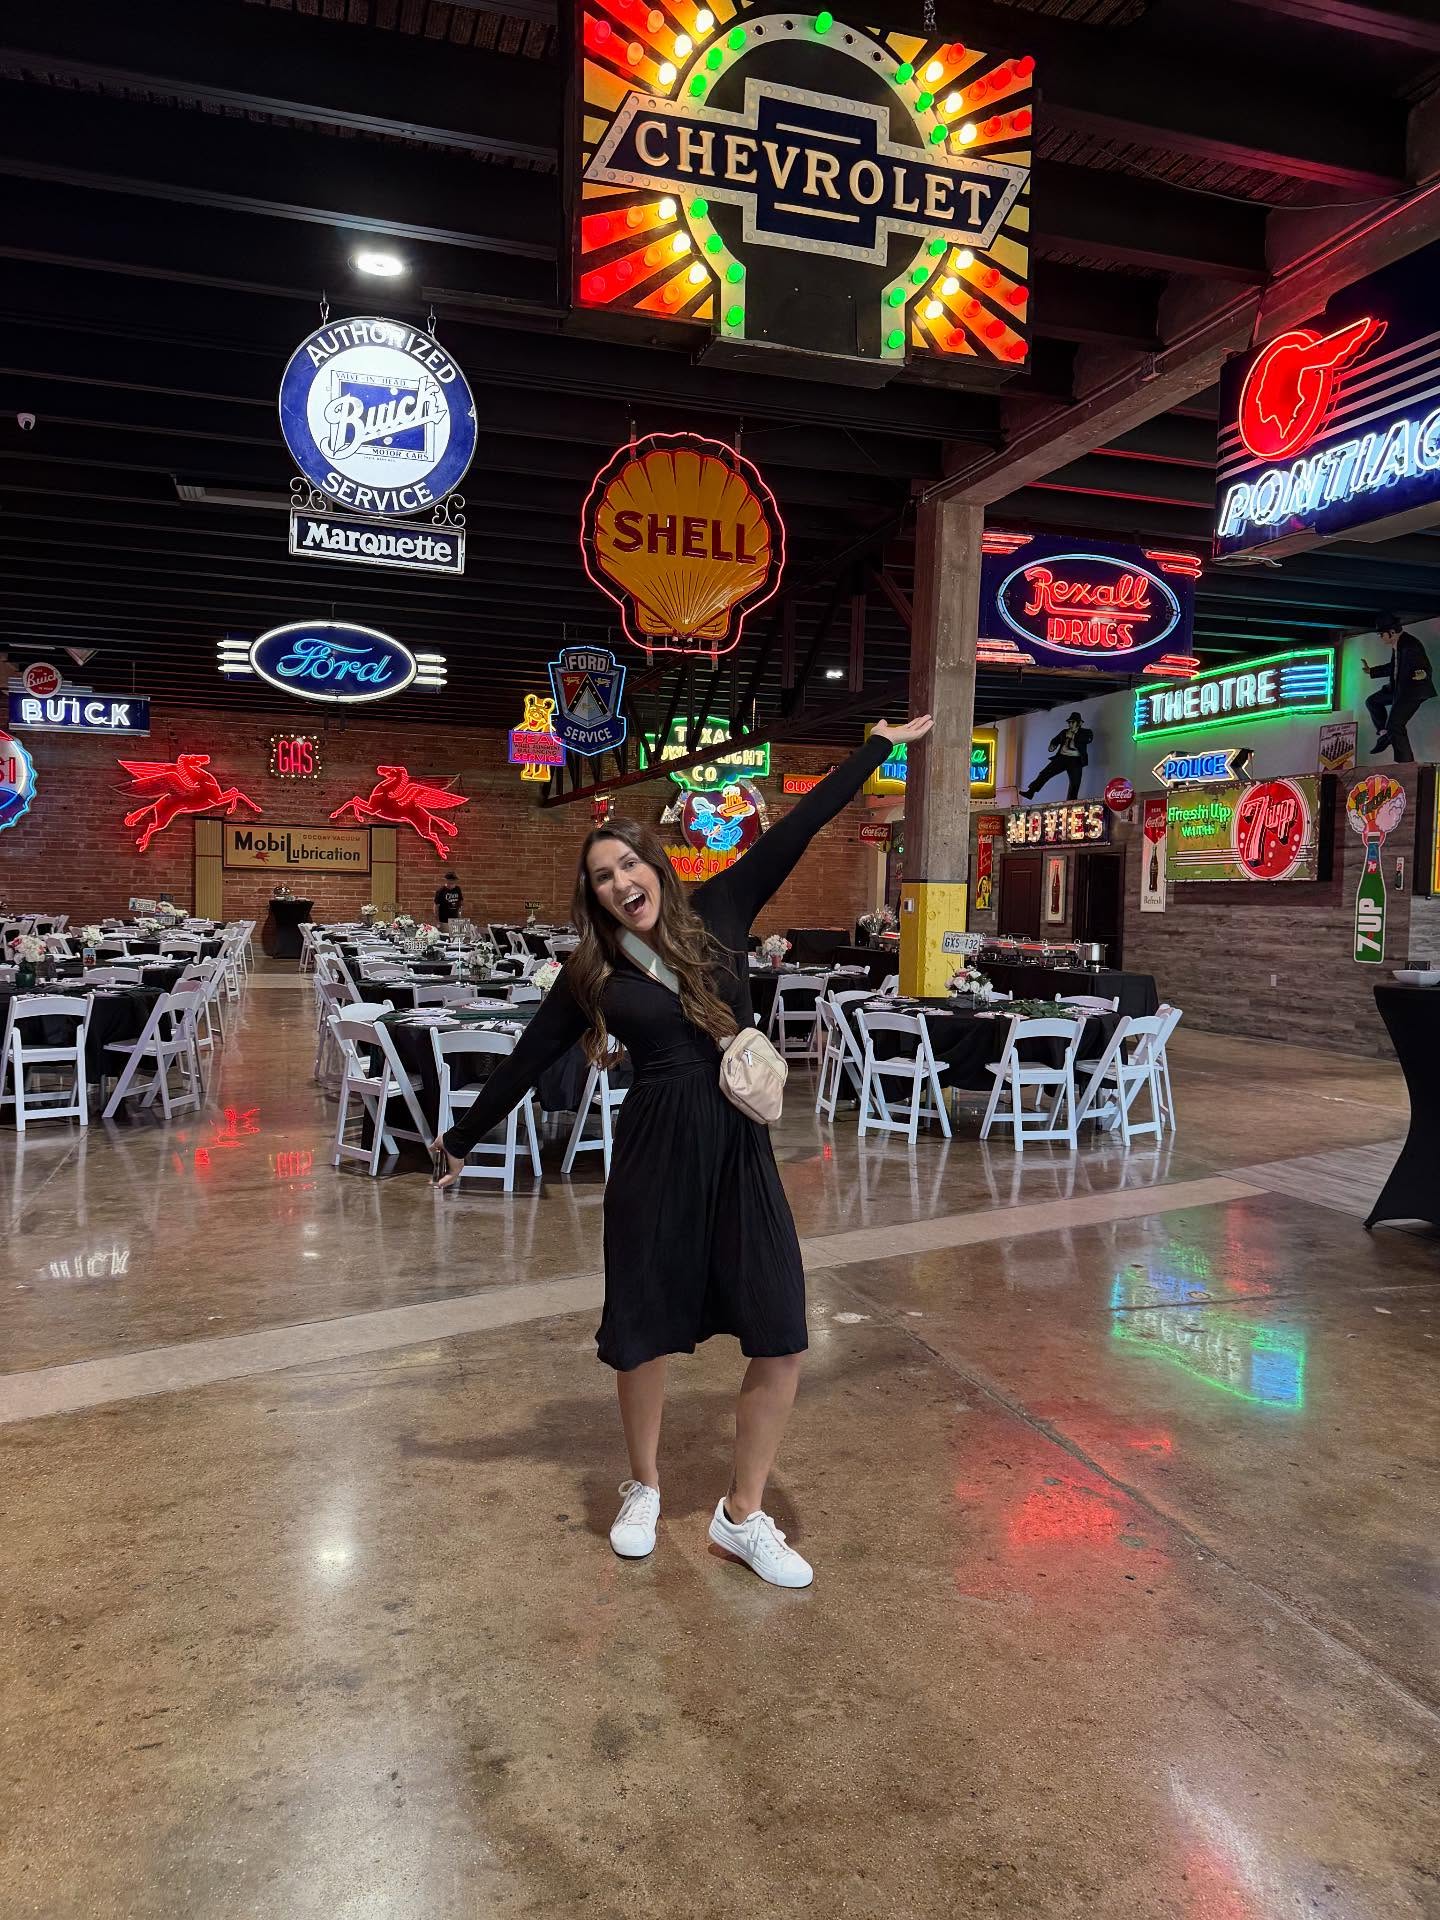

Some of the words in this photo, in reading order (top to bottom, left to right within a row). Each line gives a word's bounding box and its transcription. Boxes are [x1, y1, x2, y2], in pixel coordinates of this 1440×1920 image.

[634, 119, 992, 227] CHEVROLET
[306, 321, 457, 384] AUTHORIZED
[320, 375, 447, 460] Buick
[372, 448, 401, 457] MOTOR
[405, 452, 429, 461] CARS
[1216, 406, 1440, 538] PONTIAC
[321, 472, 434, 512] SERVICE
[302, 521, 453, 563] Marquette
[611, 509, 758, 564] SHELL
[1023, 566, 1151, 616] Rexall
[1047, 617, 1134, 650] DRUGS
[276, 638, 393, 683] Ford
[568, 655, 607, 673] FORD
[21, 697, 131, 728] BUICK
[1149, 669, 1277, 724] THEATRE
[563, 726, 613, 743] SERVICE
[674, 726, 733, 744] TXA
[278, 740, 314, 774] GAS
[513, 752, 562, 763] SERVICE
[1165, 754, 1226, 779] POLICE
[1108, 788, 1133, 799] Coca-Cola
[1007, 805, 1104, 844] MOVIES
[1168, 806, 1209, 823] Fresh
[1210, 803, 1232, 823] Up
